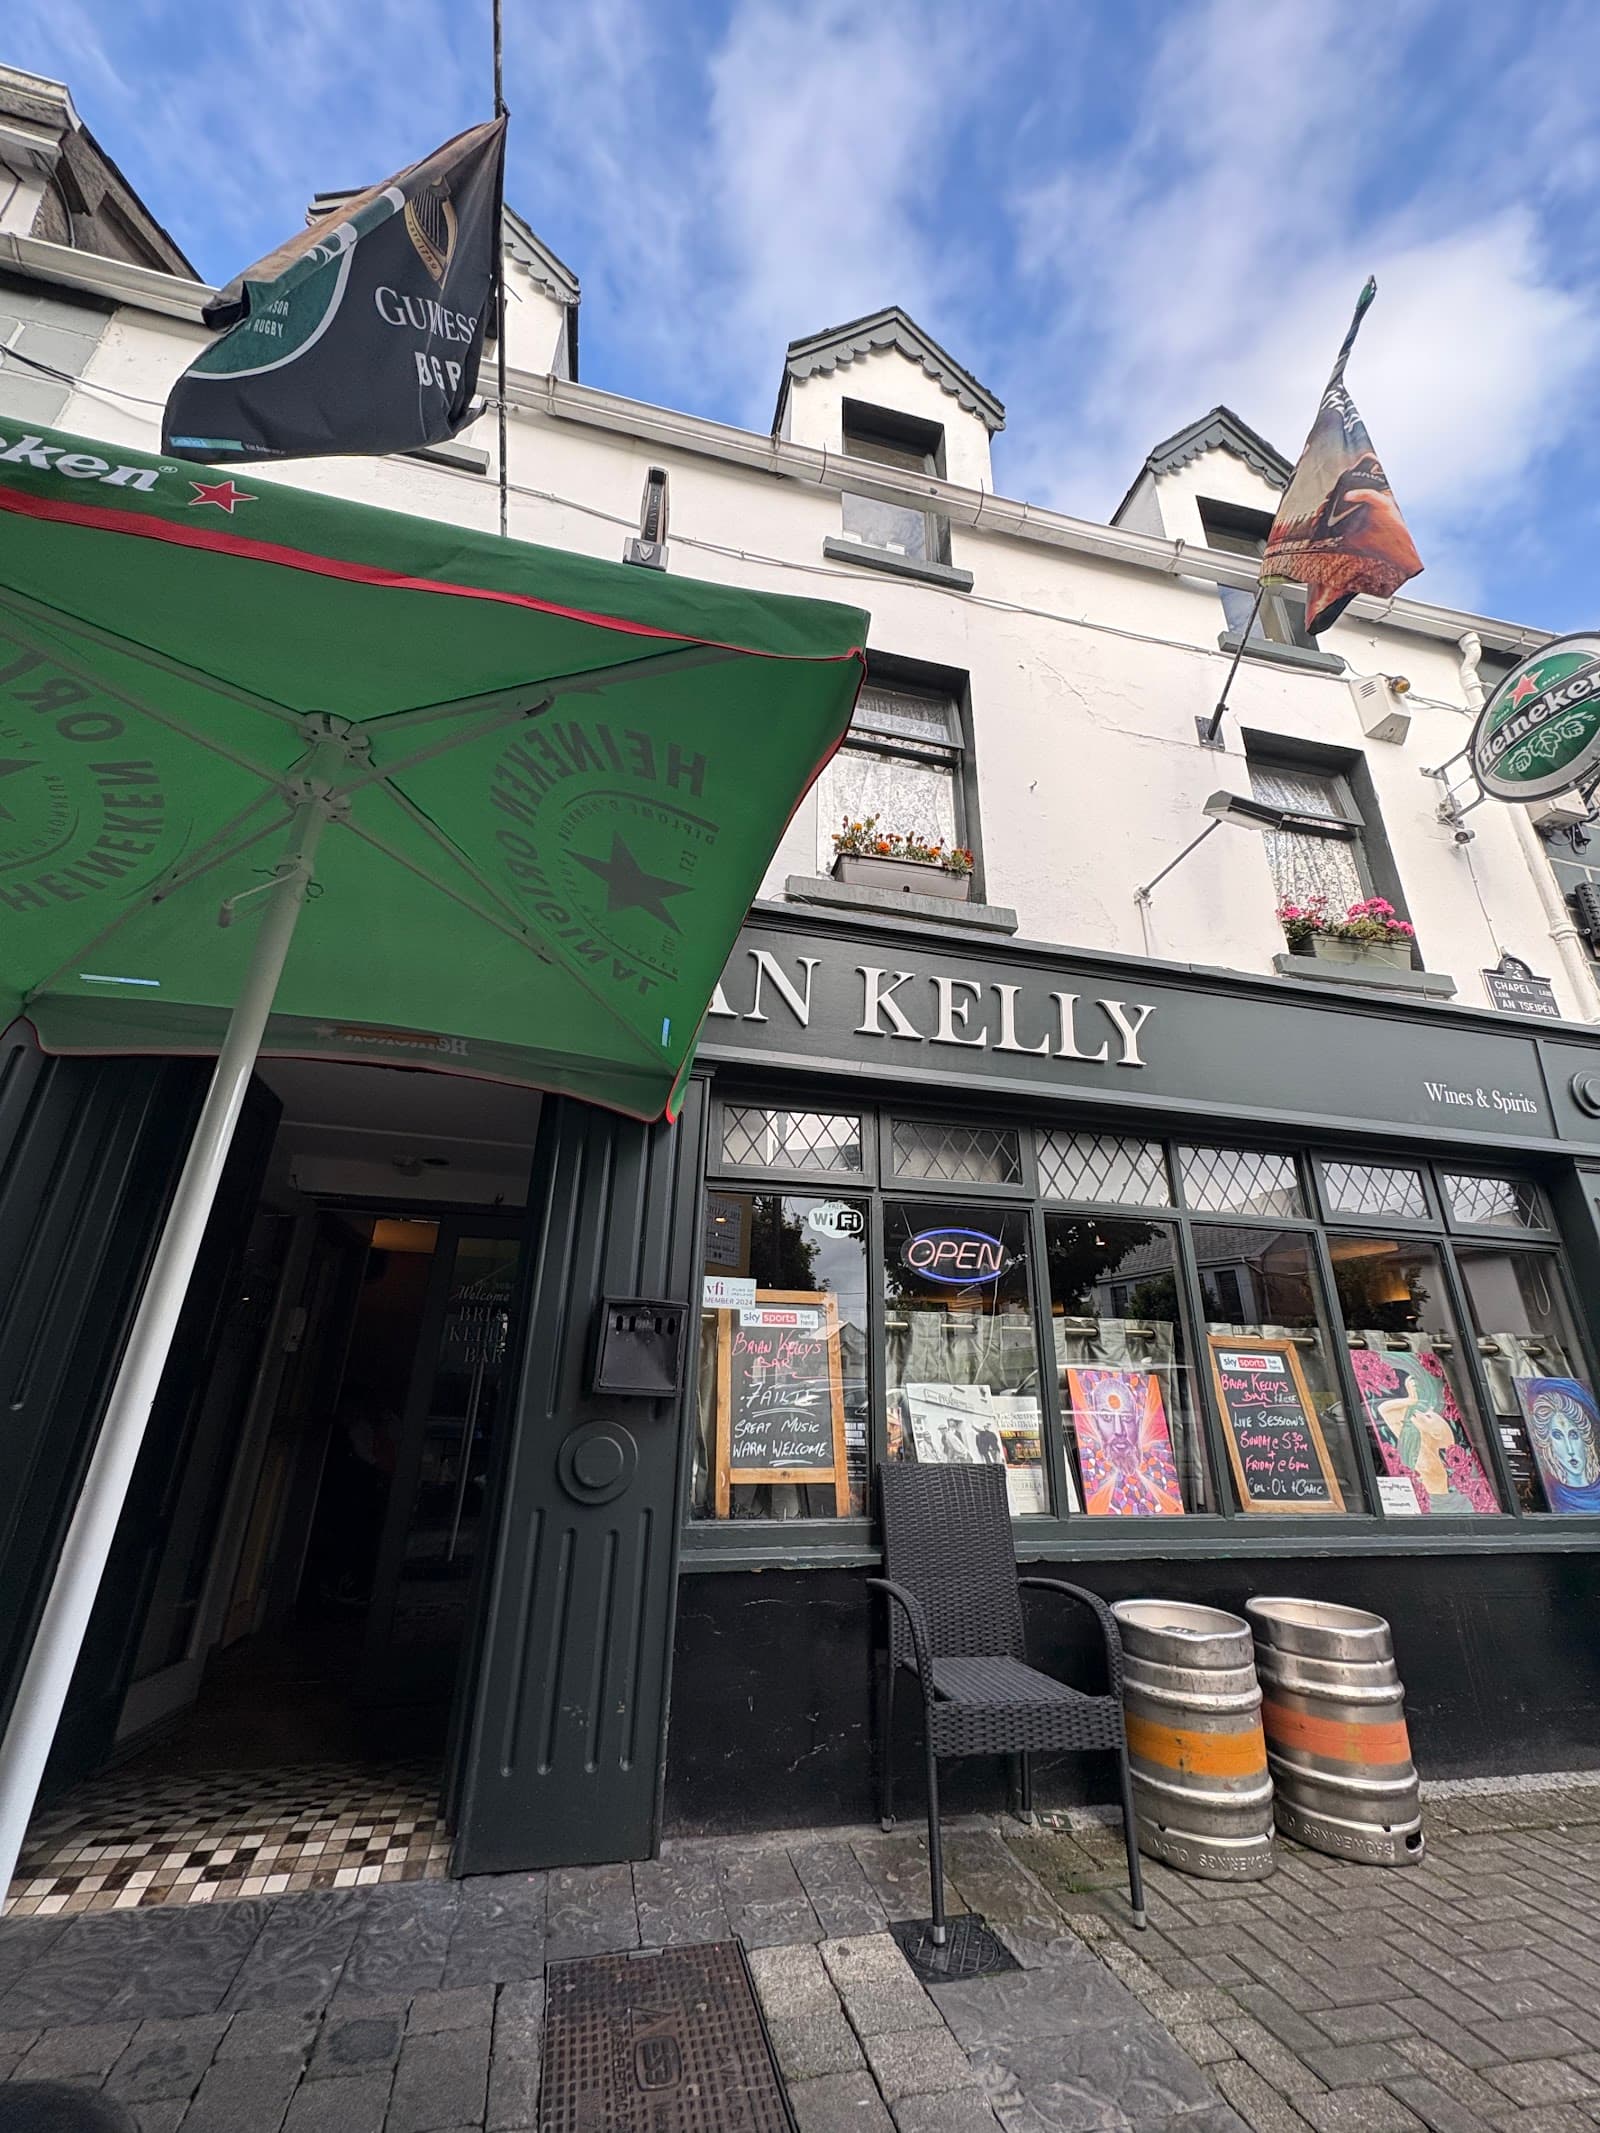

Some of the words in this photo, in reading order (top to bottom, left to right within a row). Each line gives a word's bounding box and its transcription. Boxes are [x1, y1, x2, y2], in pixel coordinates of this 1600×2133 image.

[253, 319, 284, 338] RUGBY
[0, 435, 160, 491] ken
[1494, 981, 1534, 995] CHAPEL
[1502, 999, 1516, 1009] AN
[854, 965, 1157, 1069] KELLY
[1424, 1081, 1474, 1106] Wines
[1476, 1088, 1491, 1109] &
[1491, 1089, 1538, 1115] Spirits
[907, 1238, 1005, 1272] OPEN
[706, 1281, 725, 1296] vfi
[704, 1297, 734, 1305] MEMBER
[735, 1298, 753, 1306] 2024
[743, 1312, 760, 1325] sky
[763, 1314, 797, 1324] sports
[1223, 1358, 1237, 1368] sky
[1239, 1359, 1266, 1369] sports
[1233, 1411, 1253, 1428] LIVE
[732, 1440, 767, 1458] WARM
[772, 1439, 828, 1458] WELCOME
